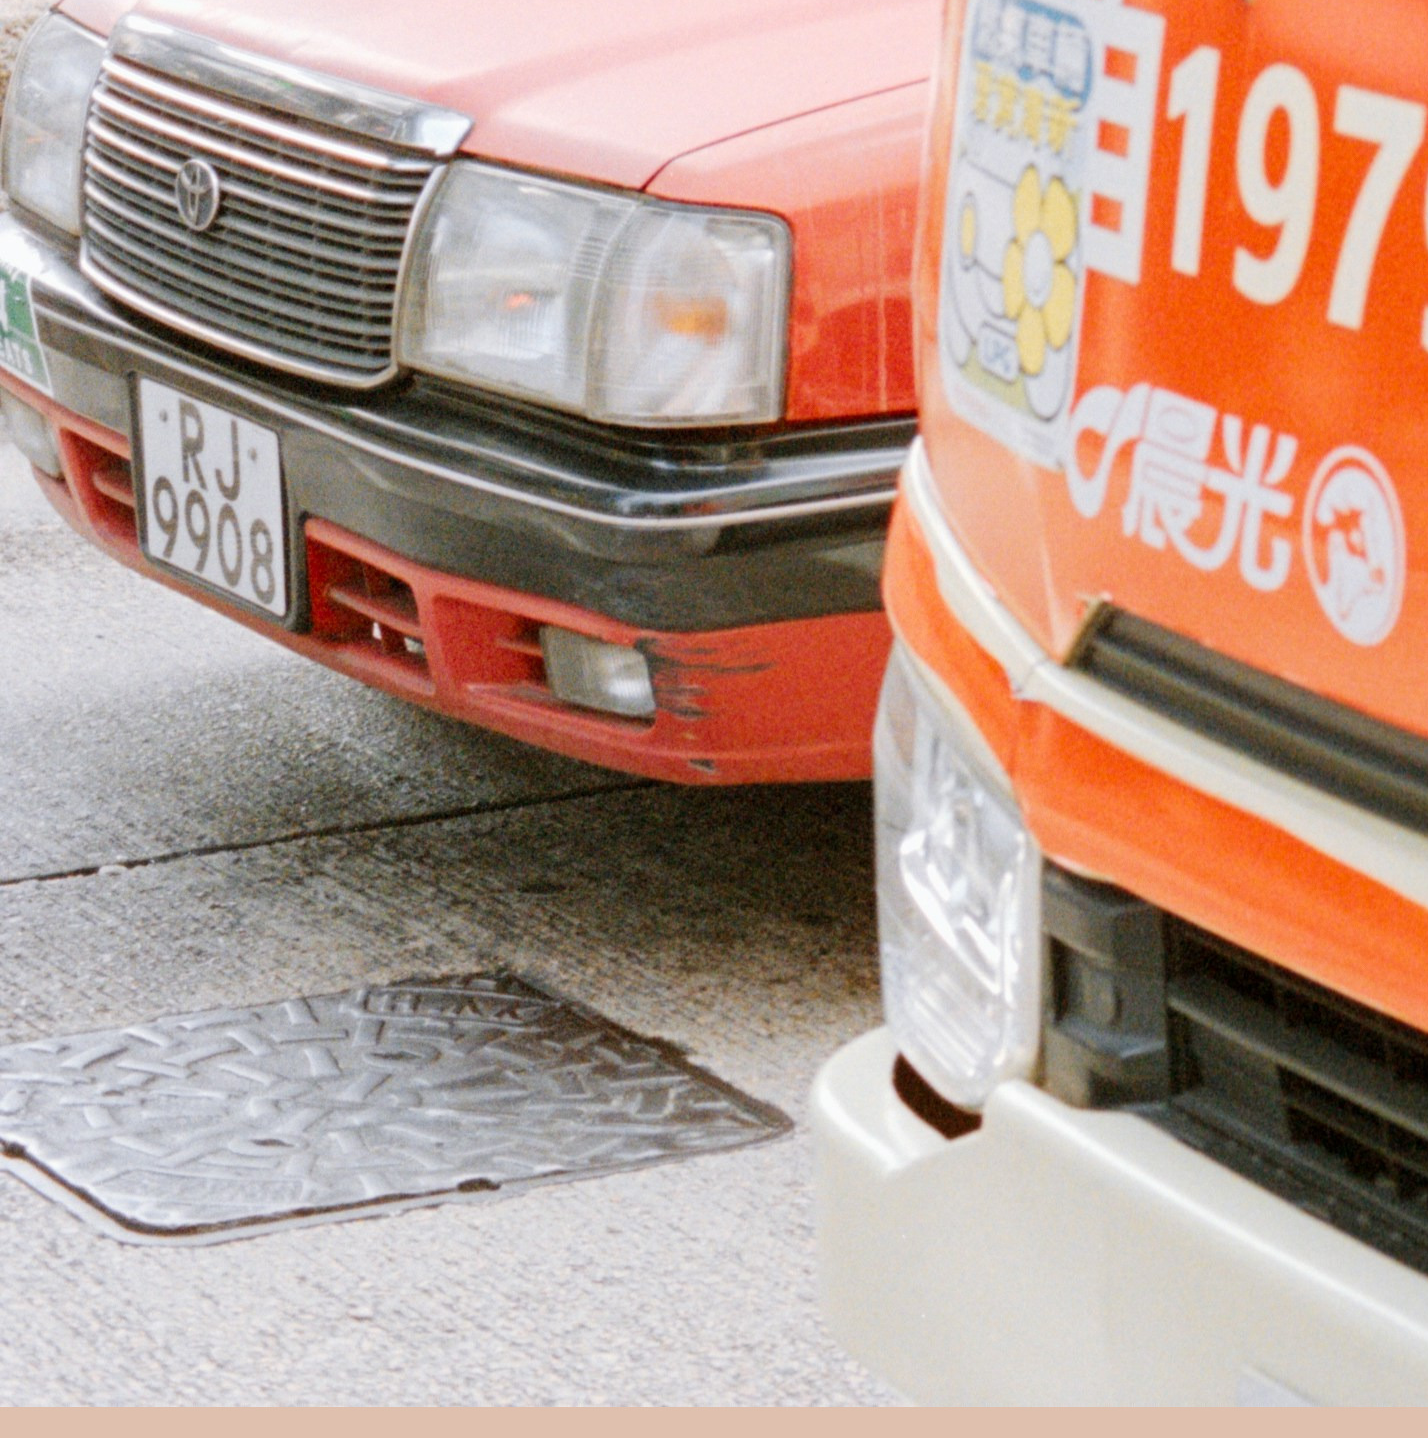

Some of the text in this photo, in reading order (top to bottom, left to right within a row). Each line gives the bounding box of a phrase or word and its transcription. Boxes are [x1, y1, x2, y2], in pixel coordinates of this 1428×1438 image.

[179, 396, 242, 502] RJ
[1067, 381, 1298, 593] 晨光
[152, 473, 276, 609] 9908
